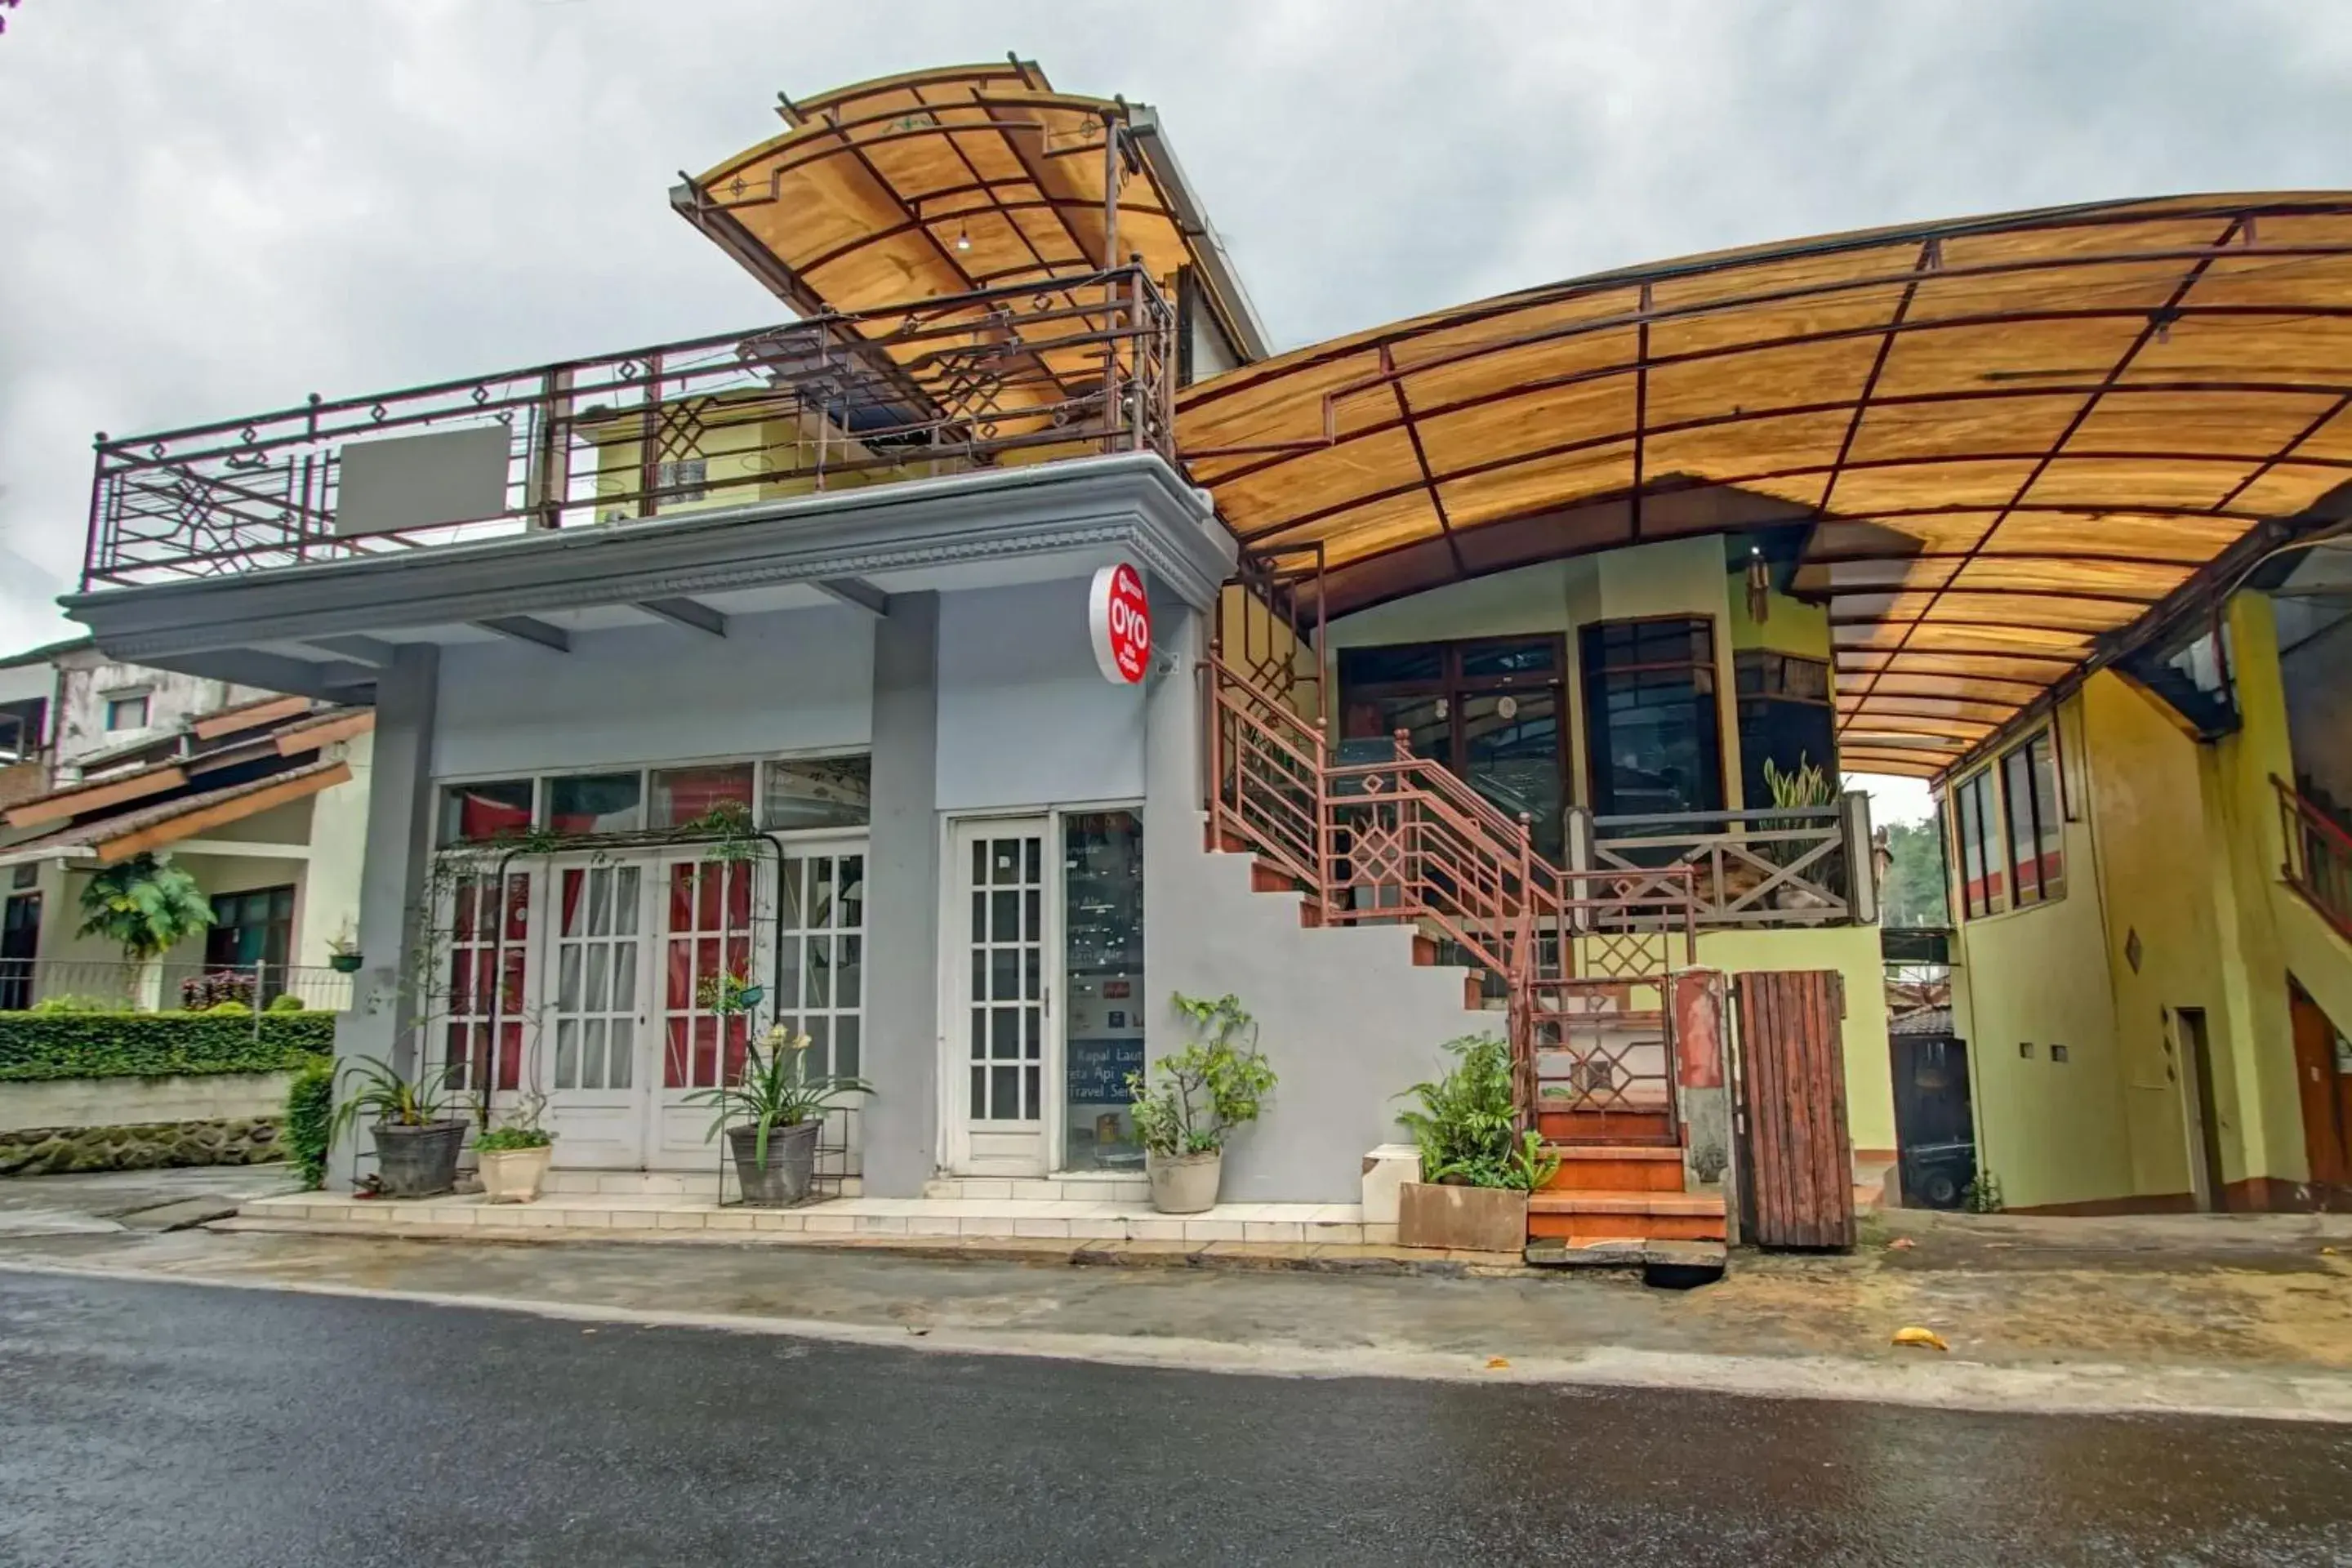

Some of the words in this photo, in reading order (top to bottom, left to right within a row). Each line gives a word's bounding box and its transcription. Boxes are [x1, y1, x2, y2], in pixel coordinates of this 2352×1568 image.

[1111, 597, 1147, 649] OYO
[1077, 1049, 1110, 1066] Kapal
[1116, 1048, 1143, 1062] Laut
[1095, 1066, 1115, 1083] Api
